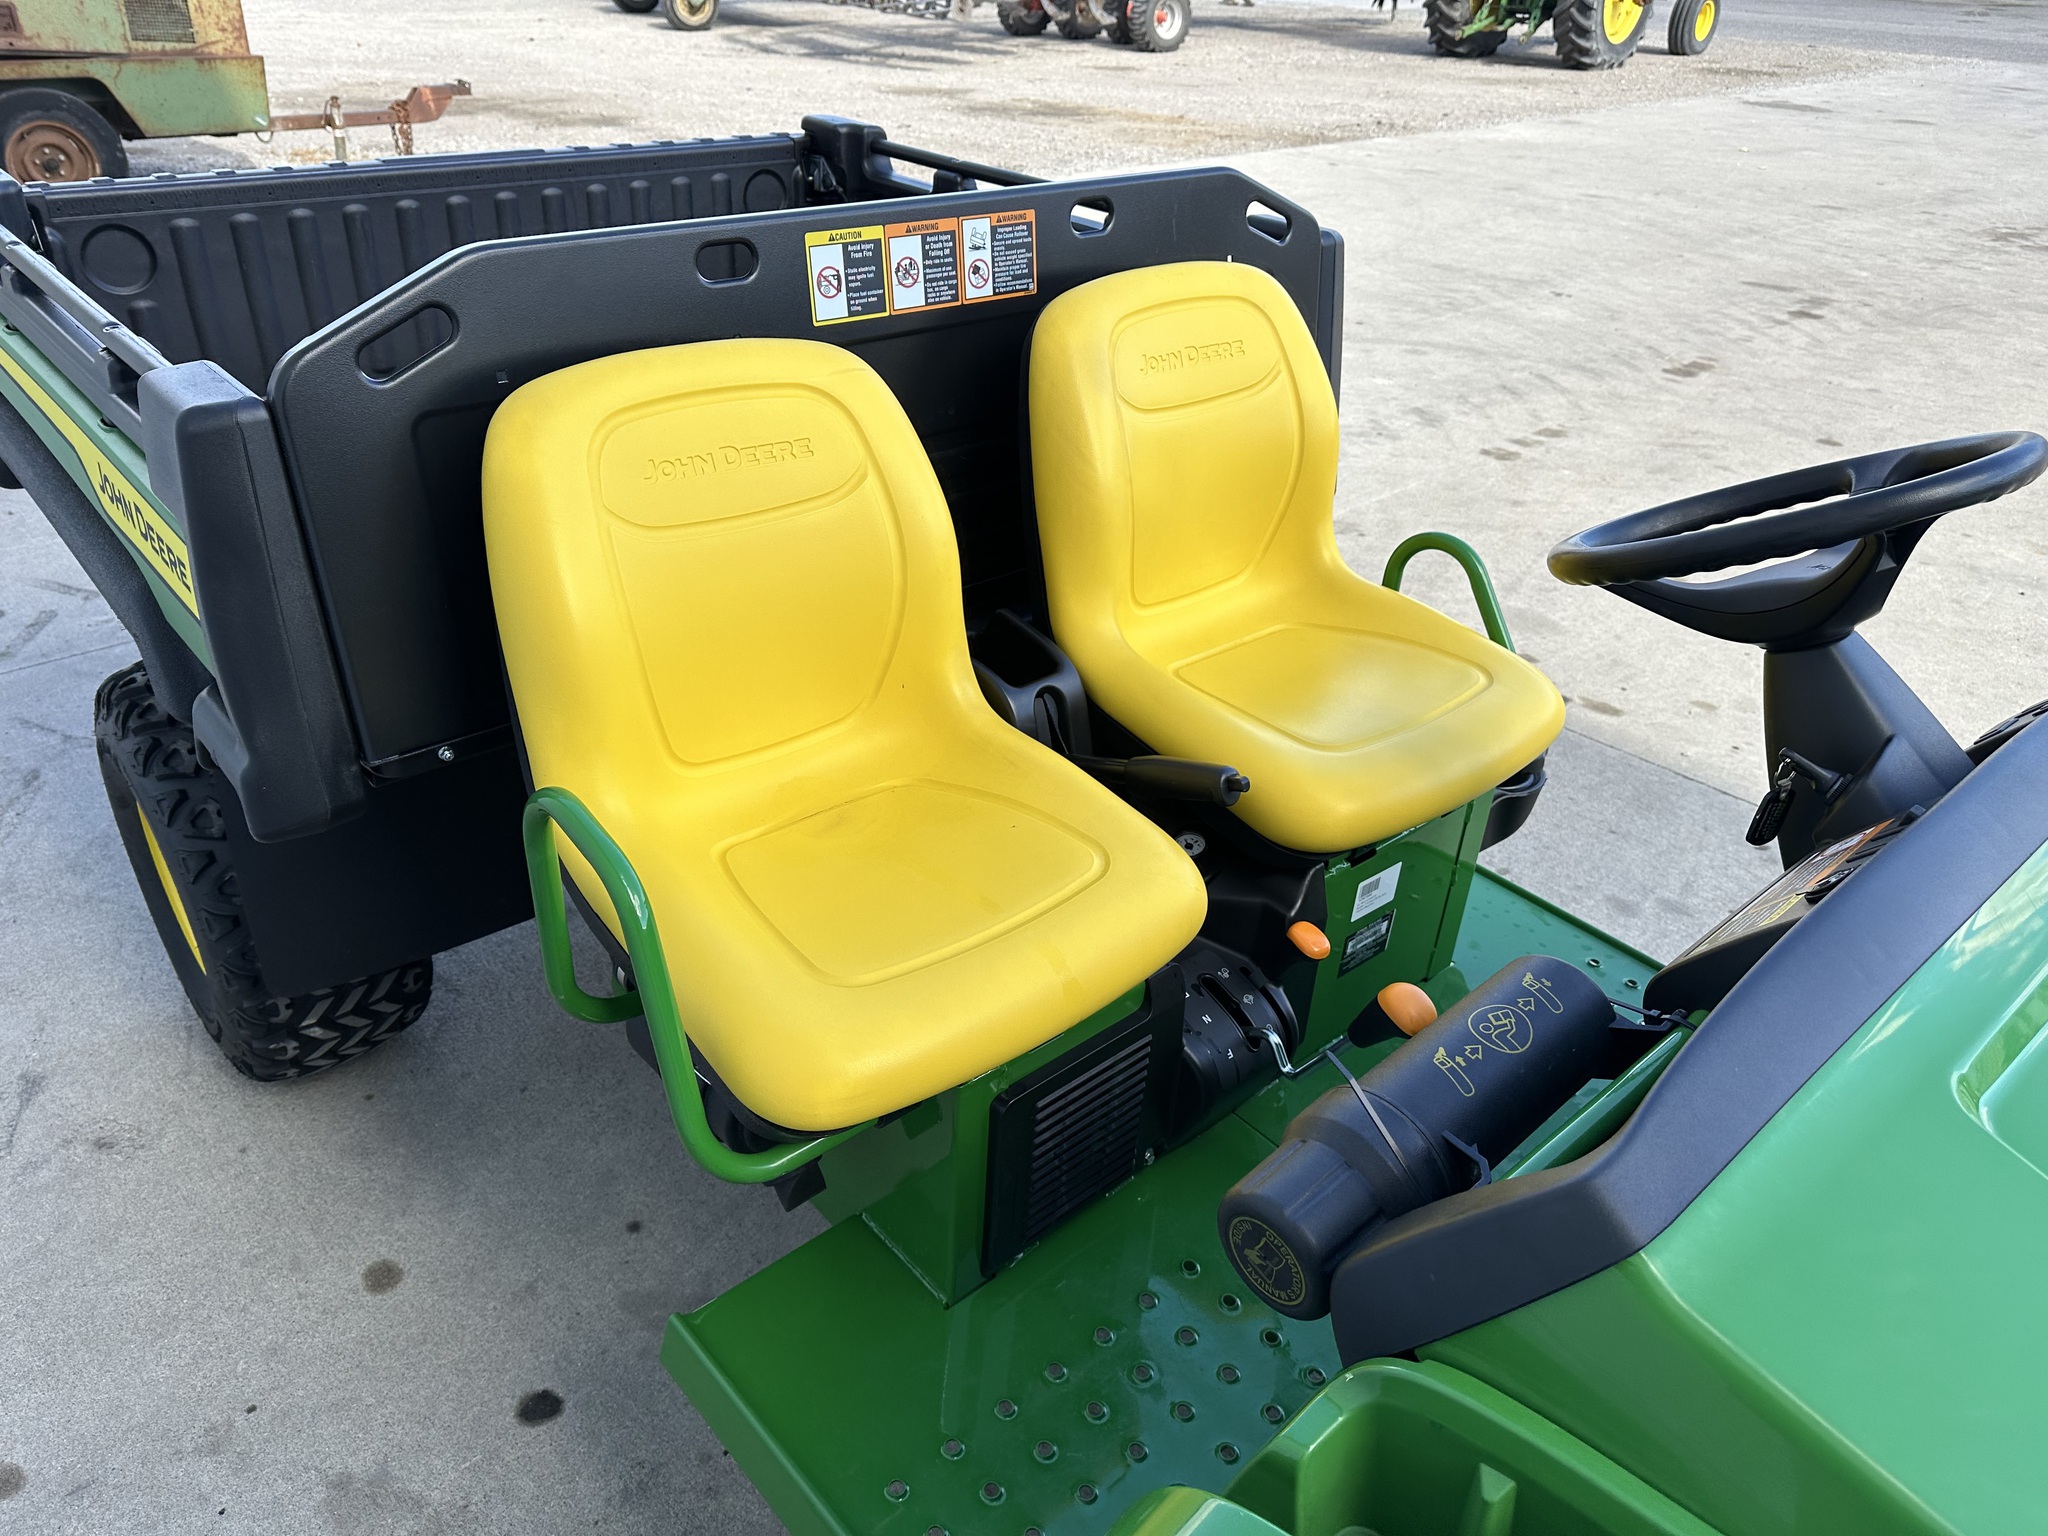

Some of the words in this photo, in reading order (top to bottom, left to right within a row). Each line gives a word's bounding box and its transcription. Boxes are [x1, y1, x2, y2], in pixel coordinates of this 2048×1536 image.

[1002, 213, 1026, 222] WARNING
[912, 222, 938, 232] WARNING
[835, 231, 862, 242] CAUTION
[861, 242, 874, 251] Injury
[1140, 350, 1184, 376] JOHN
[1184, 340, 1246, 366] DEERE
[644, 452, 716, 485] JOHN
[718, 437, 814, 471] DEERE
[97, 462, 137, 530] JOHN
[134, 502, 192, 594] DEERE
[1202, 1014, 1212, 1024] N
[1227, 1048, 1234, 1059] F
[1233, 1220, 1252, 1246] INSIDE
[1247, 1264, 1288, 1301] MANUAL
